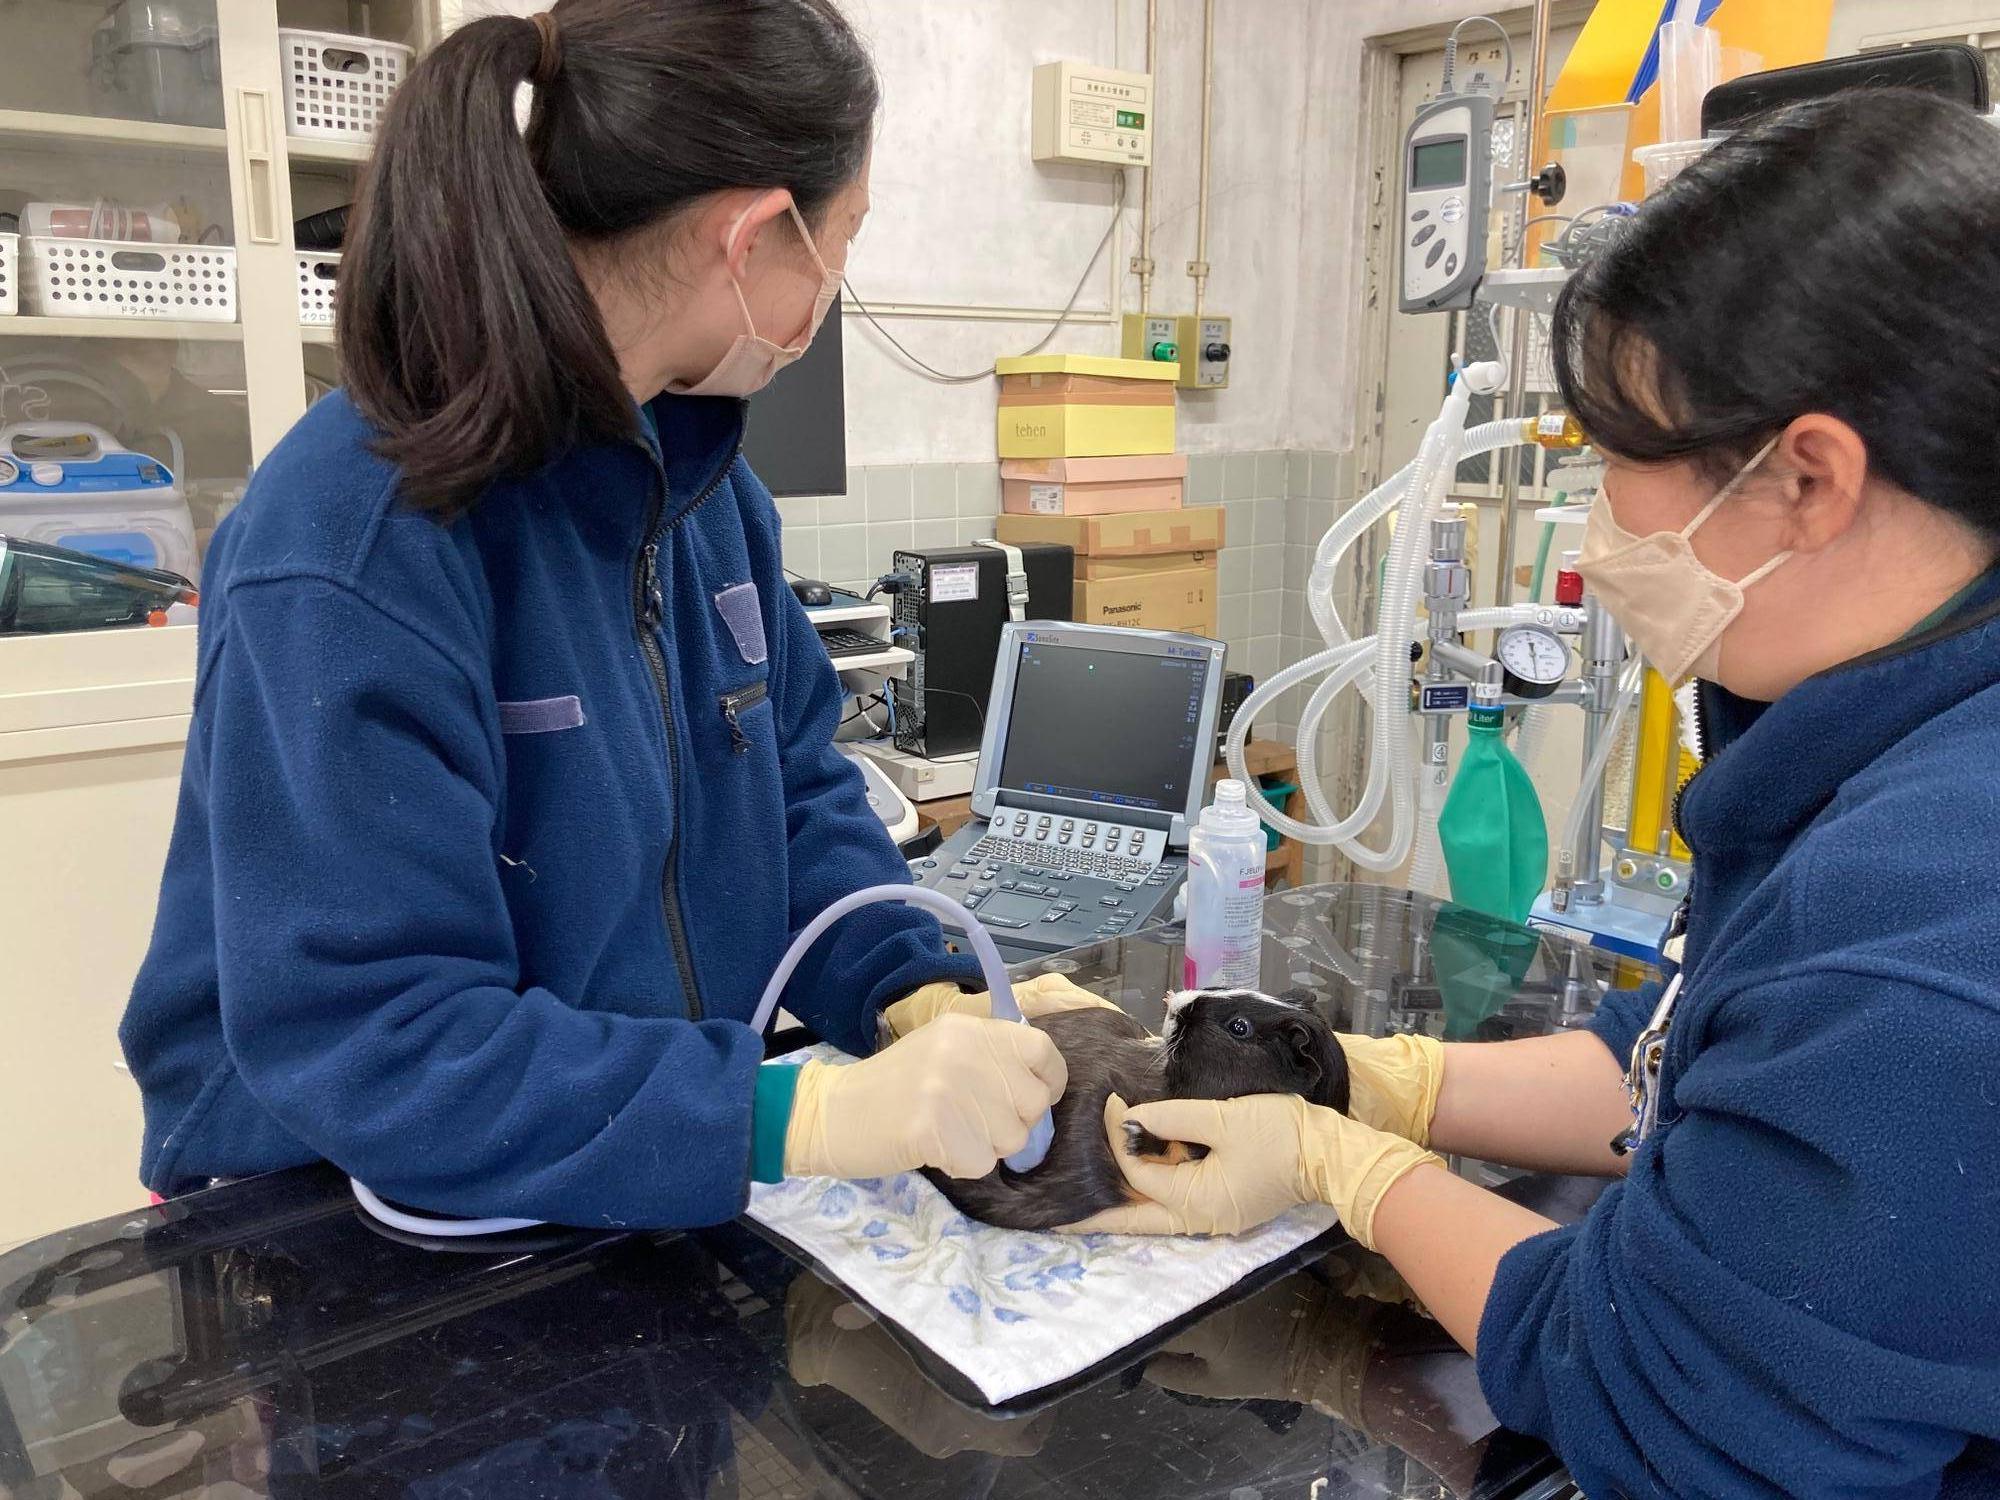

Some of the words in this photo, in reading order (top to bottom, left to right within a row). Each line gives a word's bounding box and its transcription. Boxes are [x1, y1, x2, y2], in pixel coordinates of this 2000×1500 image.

[121, 305, 168, 316] ドライヤー
[1103, 601, 1142, 615] Panasonic
[1473, 712, 1495, 723] Liter
